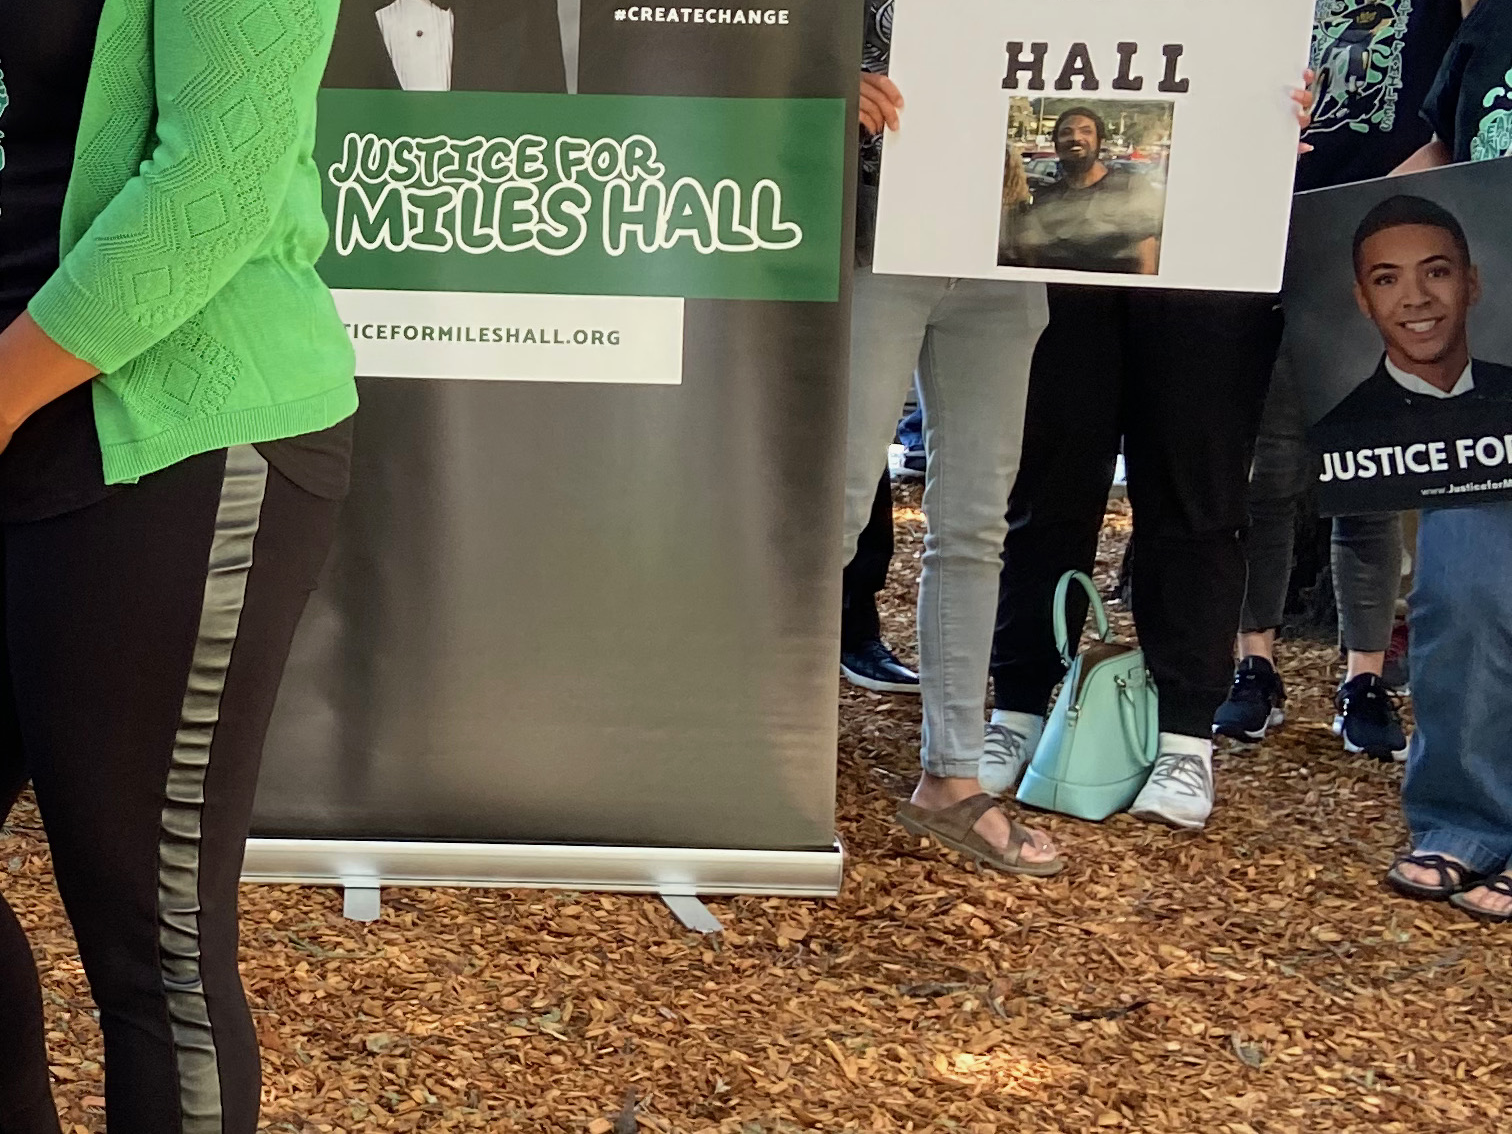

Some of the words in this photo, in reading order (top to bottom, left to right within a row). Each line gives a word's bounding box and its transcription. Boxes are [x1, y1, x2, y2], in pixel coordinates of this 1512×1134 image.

[614, 6, 789, 26] #CREATECHANGE
[1002, 41, 1190, 93] HALL
[329, 132, 547, 185] JUSTICE
[554, 135, 664, 183] FOR
[334, 182, 591, 256] MILES
[603, 177, 803, 256] HALL
[1319, 441, 1449, 482] JUSTICE
